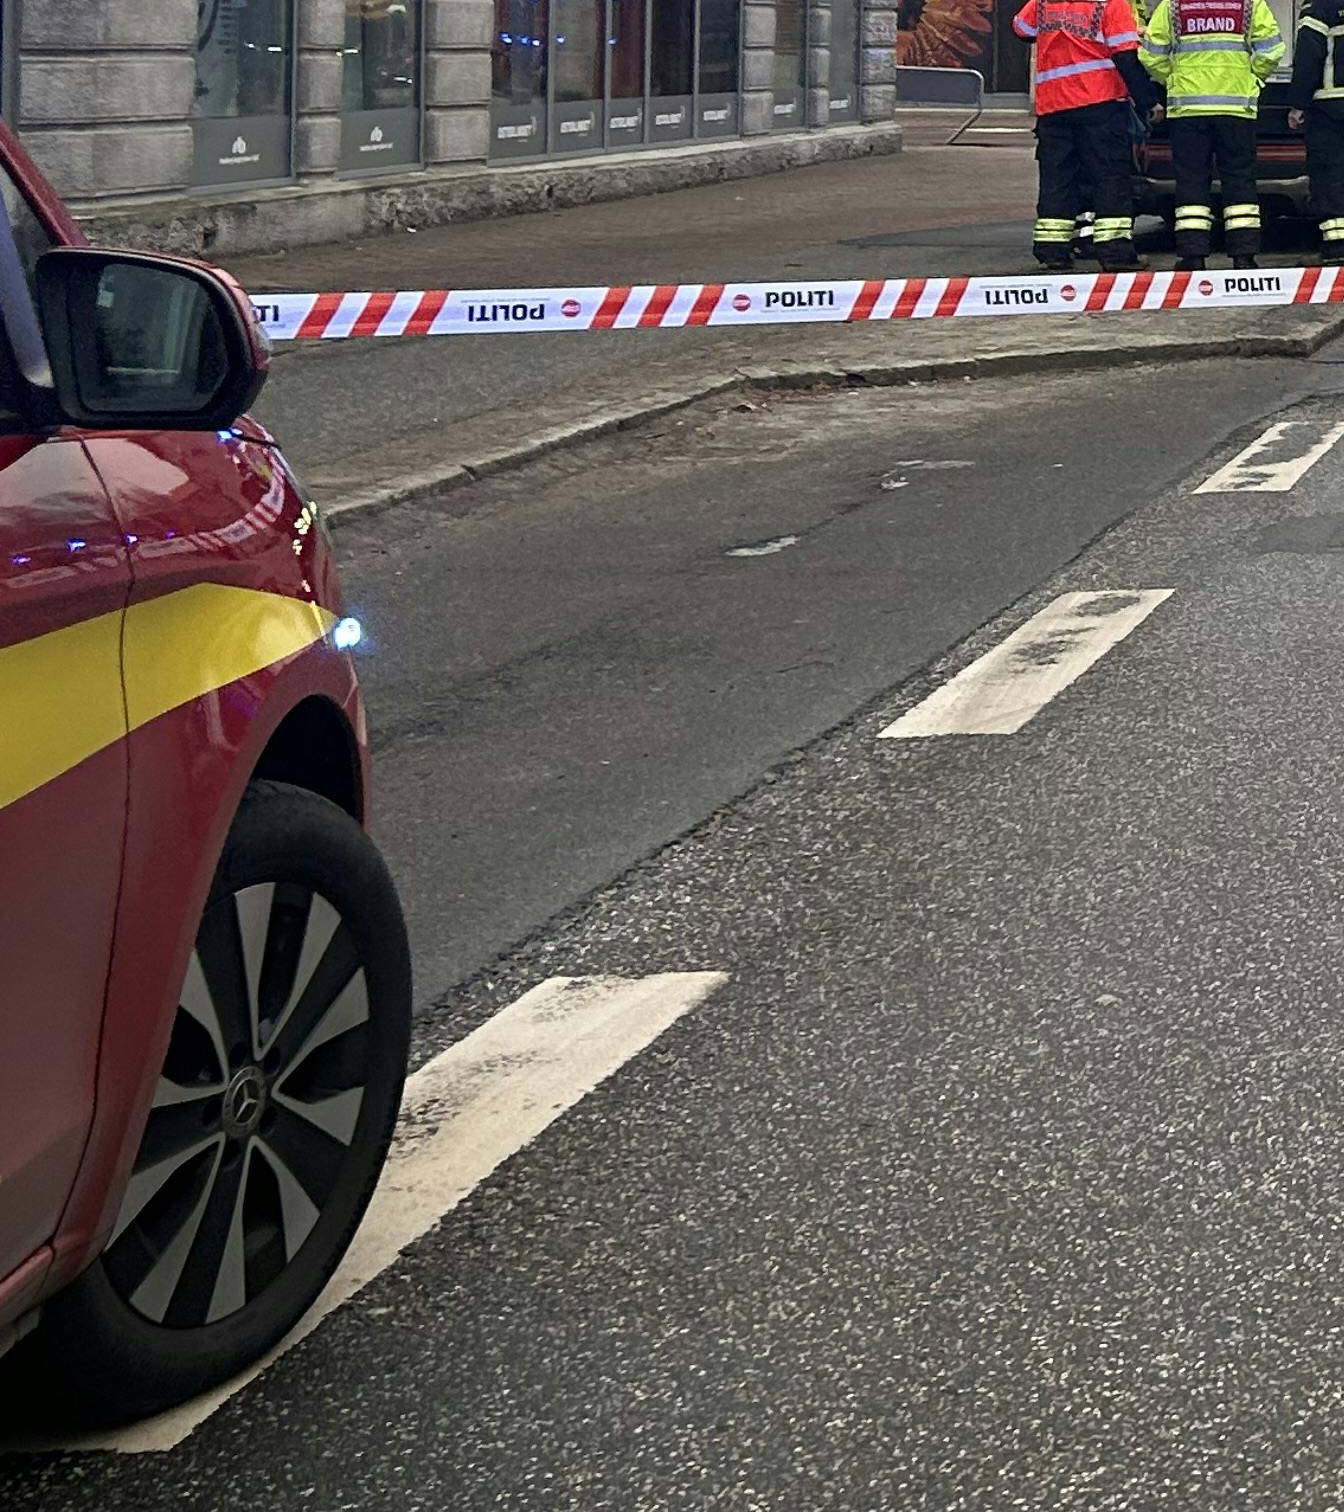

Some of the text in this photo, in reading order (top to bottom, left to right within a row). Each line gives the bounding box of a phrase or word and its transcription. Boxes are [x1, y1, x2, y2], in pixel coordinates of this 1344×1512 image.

[1186, 17, 1236, 33] BRAND
[1224, 277, 1281, 293] POLITI
[765, 290, 834, 308] POLITI
[985, 288, 1049, 306] POLITI
[468, 303, 545, 322] POLITI
